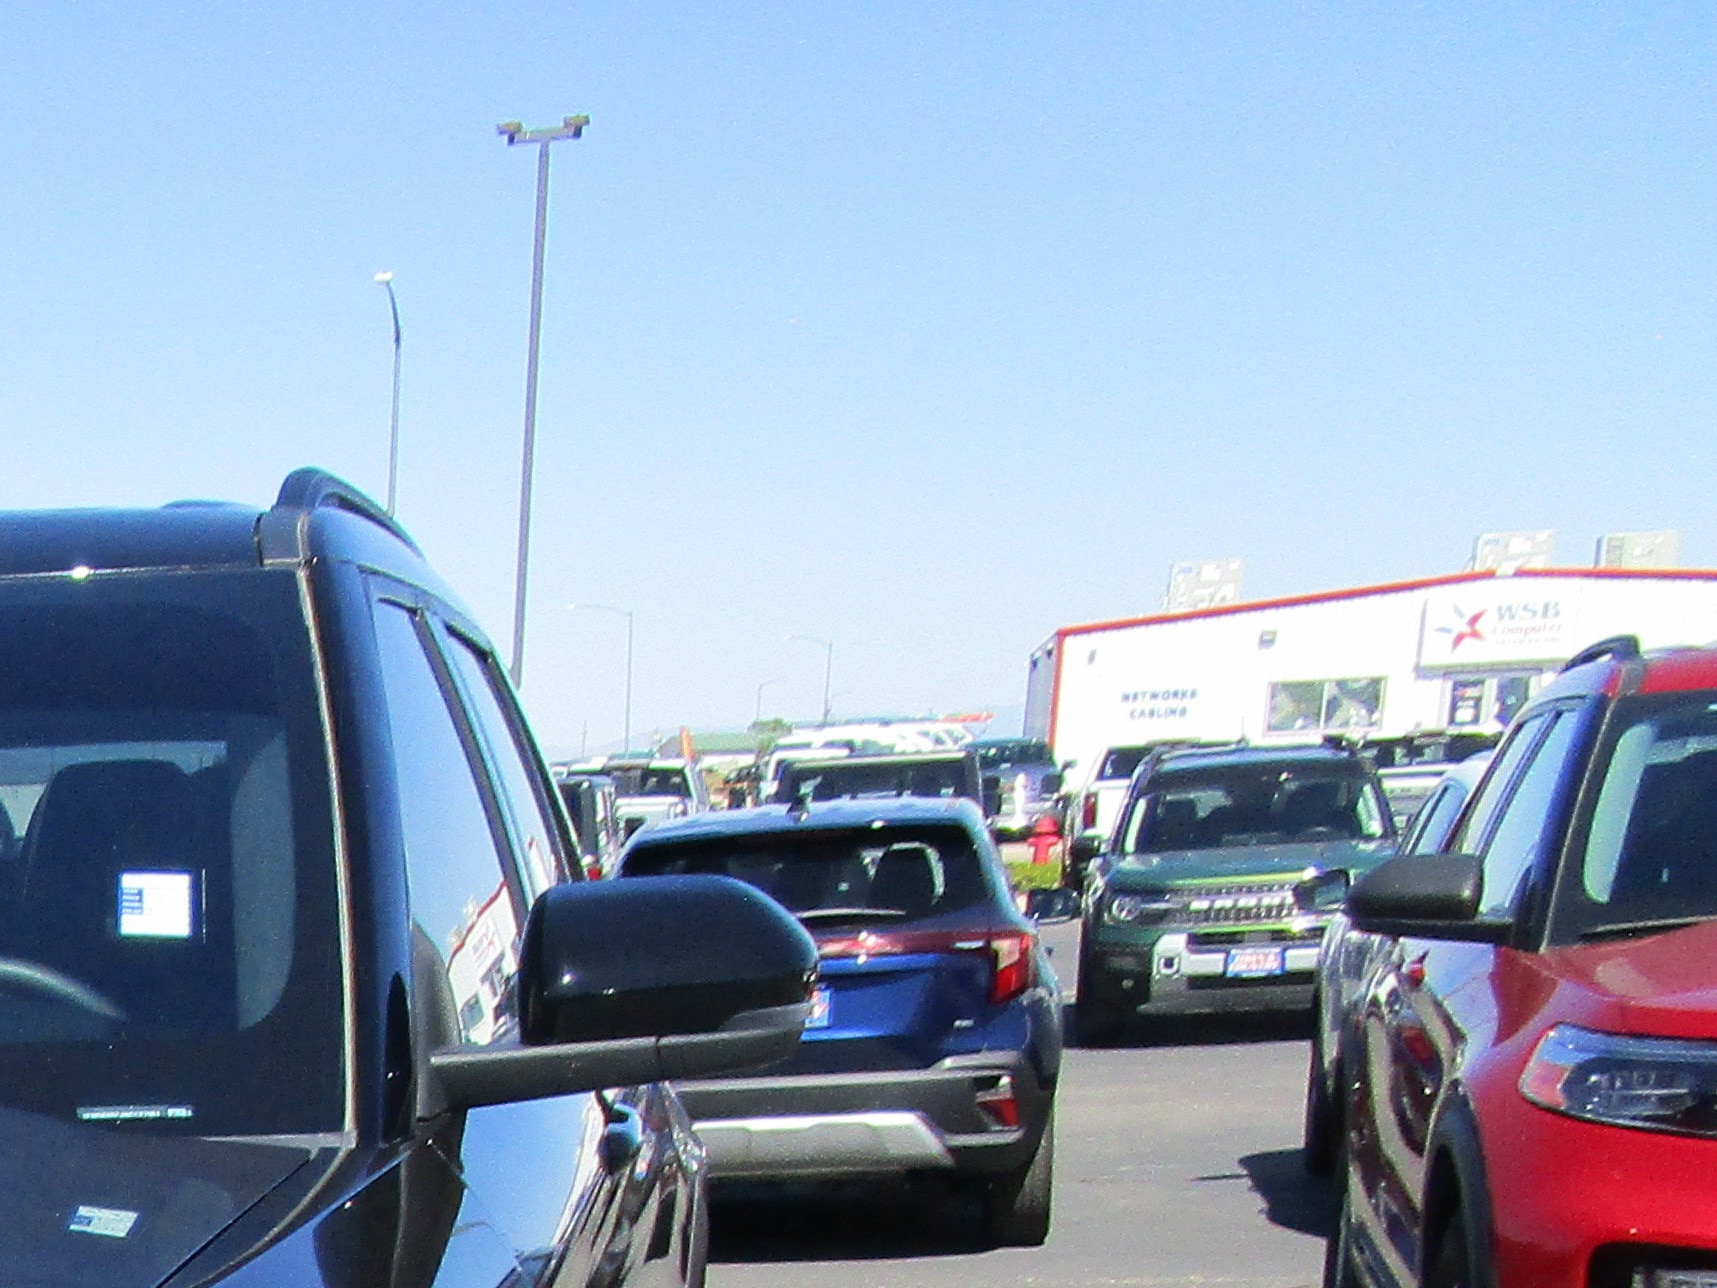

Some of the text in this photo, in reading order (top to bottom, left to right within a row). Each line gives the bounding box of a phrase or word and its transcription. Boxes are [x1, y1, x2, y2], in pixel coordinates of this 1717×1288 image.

[1496, 600, 1562, 622] WSB
[1121, 688, 1198, 703] NETWORKS
[1129, 706, 1188, 721] CABLING
